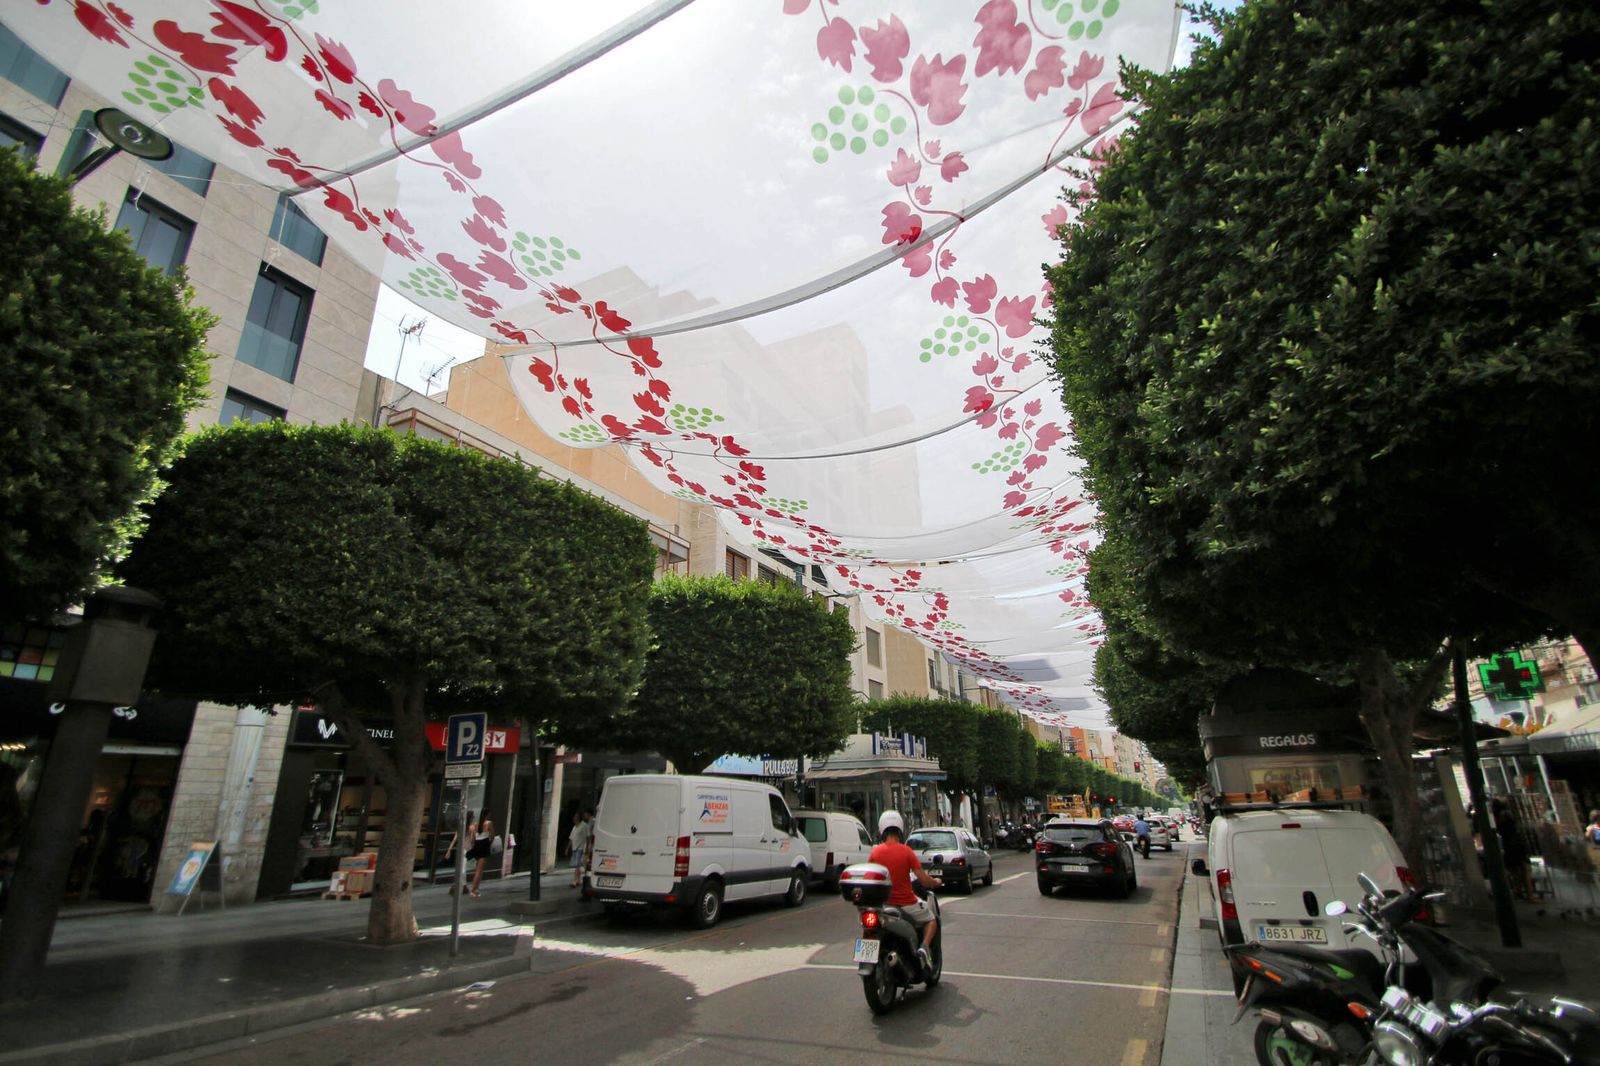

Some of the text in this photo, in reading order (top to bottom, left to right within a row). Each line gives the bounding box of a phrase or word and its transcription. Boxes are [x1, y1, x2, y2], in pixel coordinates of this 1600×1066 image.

[456, 721, 477, 756] P
[1260, 734, 1316, 748] REGALOS
[466, 744, 480, 756] Z2
[1266, 928, 1323, 941] 8631 JRZ
